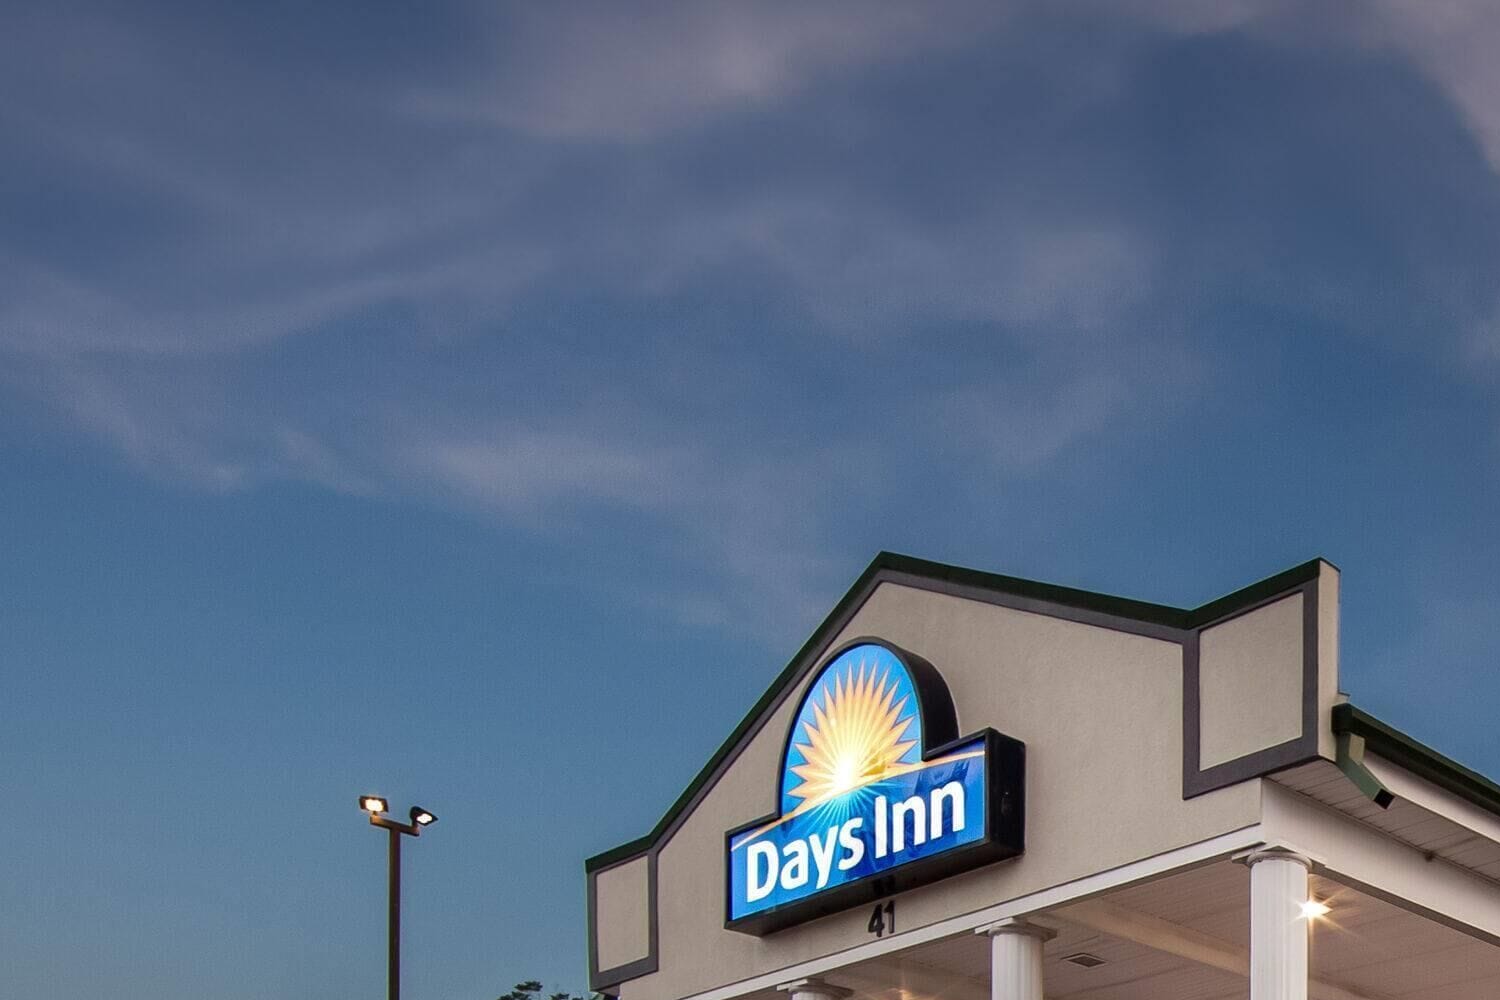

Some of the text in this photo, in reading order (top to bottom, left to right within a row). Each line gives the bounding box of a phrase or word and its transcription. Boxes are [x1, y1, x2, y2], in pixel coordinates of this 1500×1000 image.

[746, 781, 965, 903] Days Inn
[867, 901, 895, 937] 41
